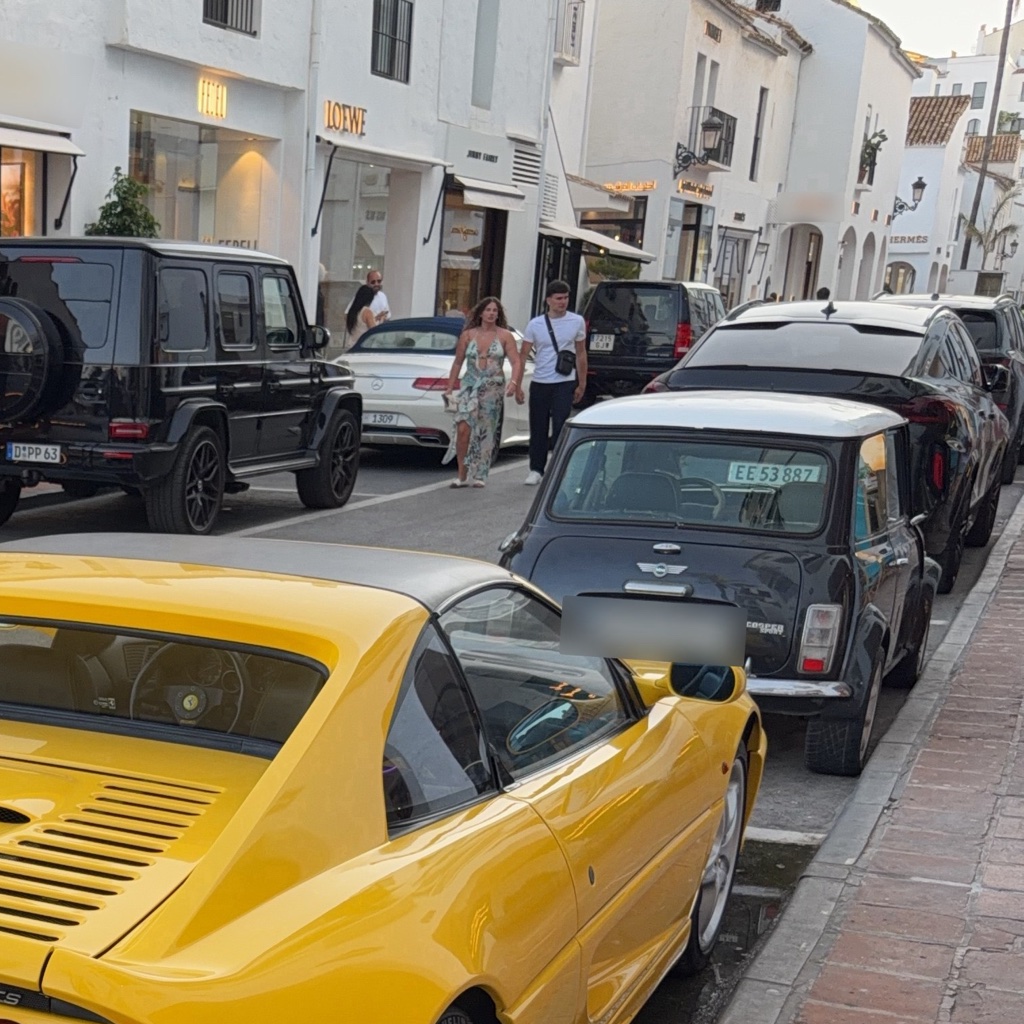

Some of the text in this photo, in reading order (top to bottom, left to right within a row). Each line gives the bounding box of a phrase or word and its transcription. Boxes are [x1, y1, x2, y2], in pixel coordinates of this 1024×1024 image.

[326, 100, 367, 136] LOEWE
[14, 446, 57, 460] D PP 63
[735, 465, 813, 482] EE 53 887
